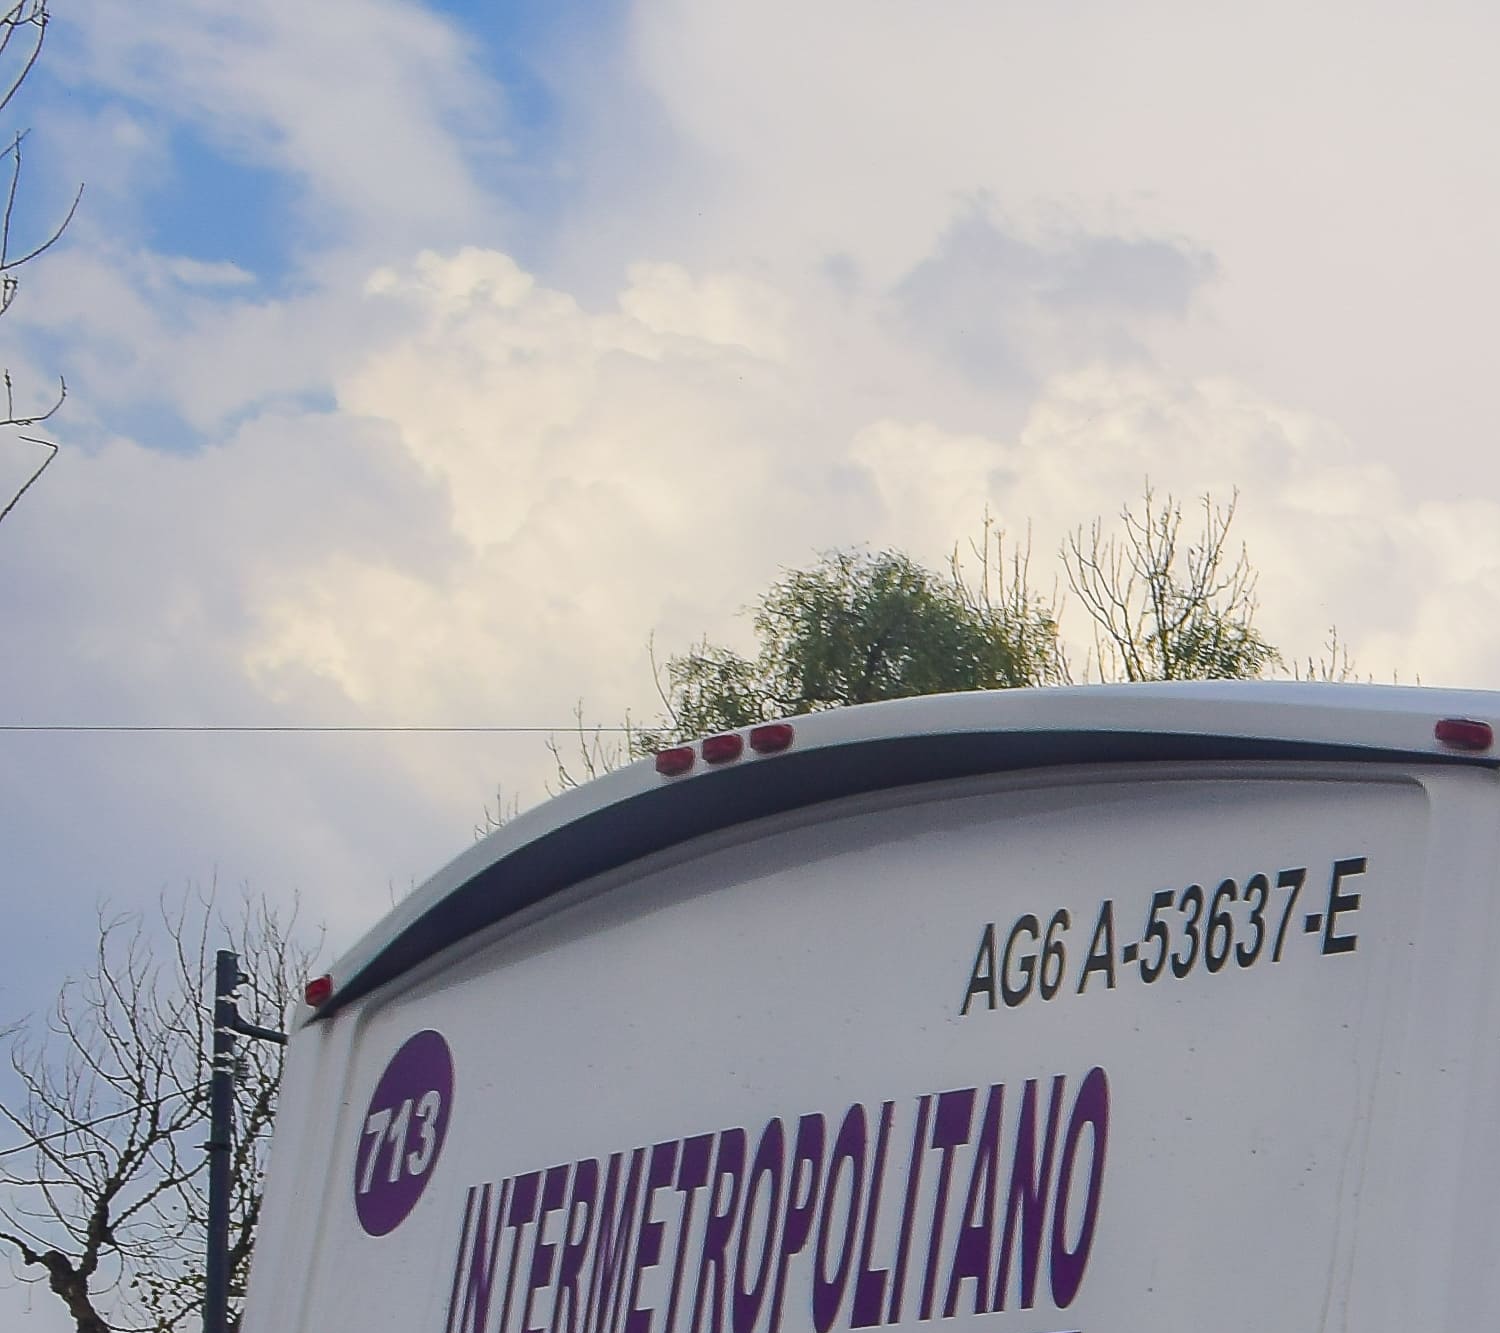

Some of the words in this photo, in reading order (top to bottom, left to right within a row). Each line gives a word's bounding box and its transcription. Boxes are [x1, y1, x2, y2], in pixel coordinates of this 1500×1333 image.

[962, 908, 1068, 1015] AG6
[1079, 857, 1367, 991] A-53637-E
[361, 1090, 441, 1188] 713
